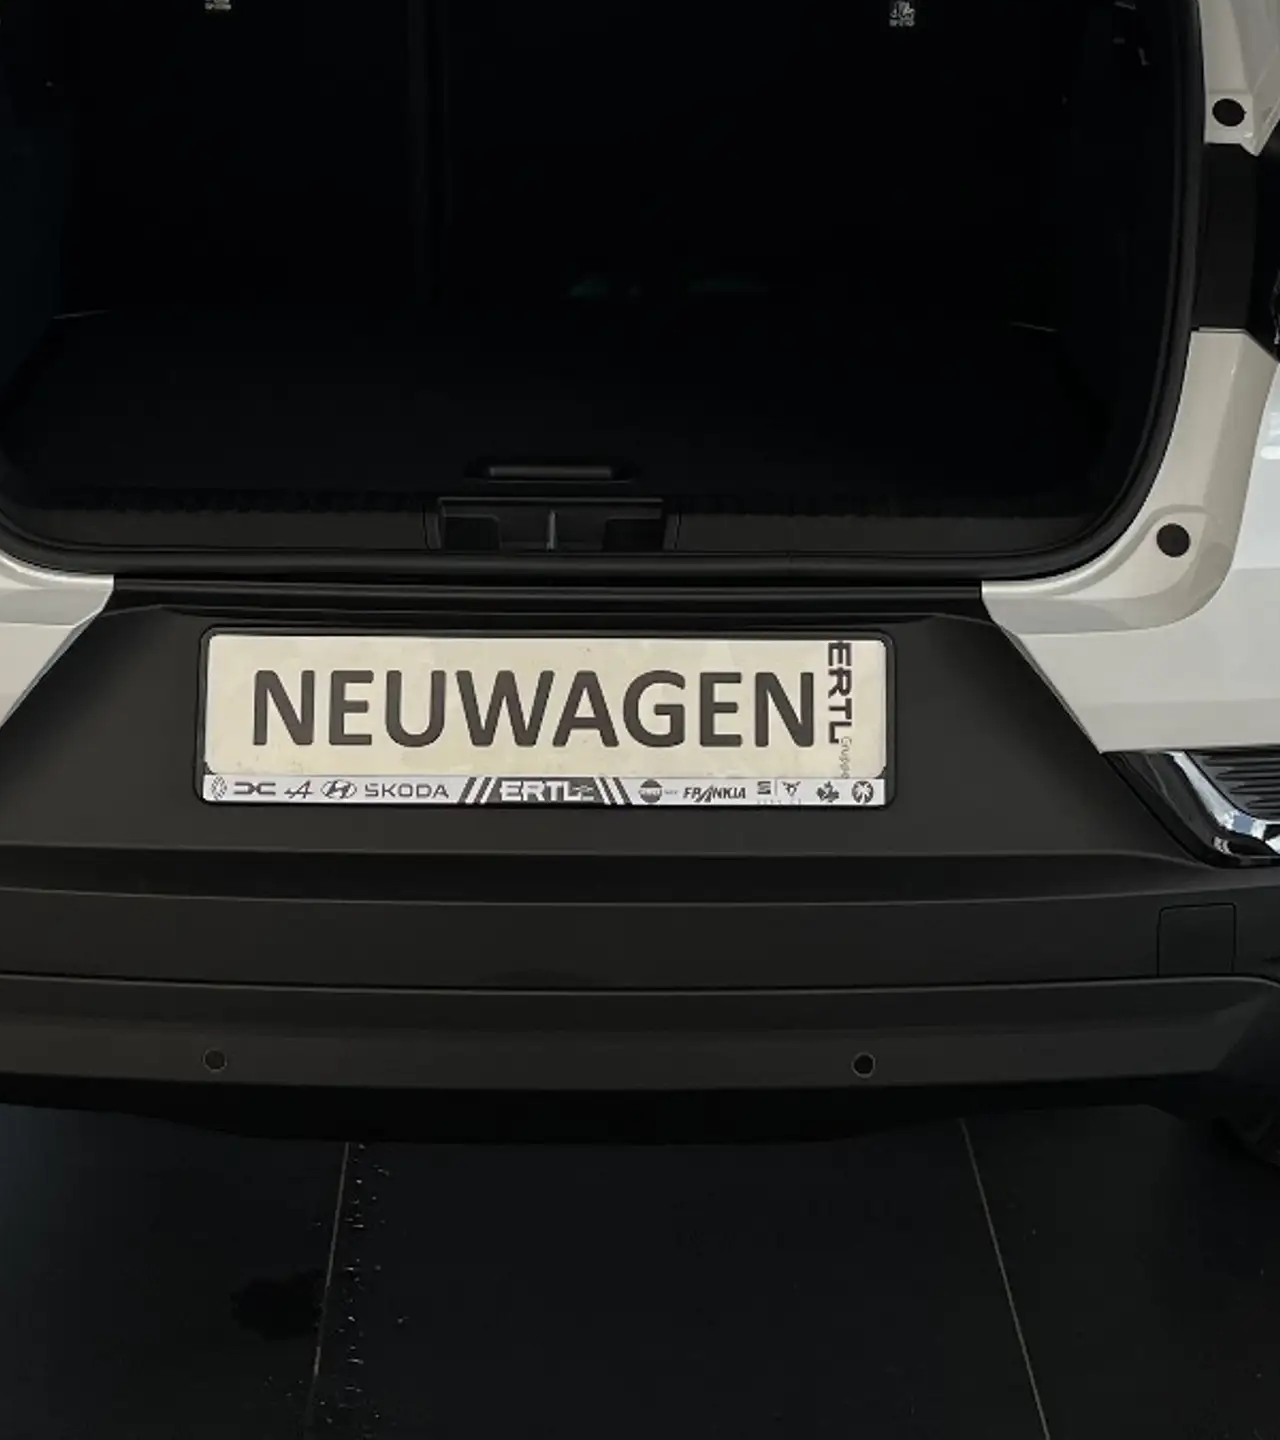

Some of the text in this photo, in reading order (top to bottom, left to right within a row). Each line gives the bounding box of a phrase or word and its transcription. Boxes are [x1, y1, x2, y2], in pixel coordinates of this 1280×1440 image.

[252, 669, 815, 748] NEUWAGEN
[828, 640, 853, 744] ERTL
[499, 780, 582, 802] ERTL
